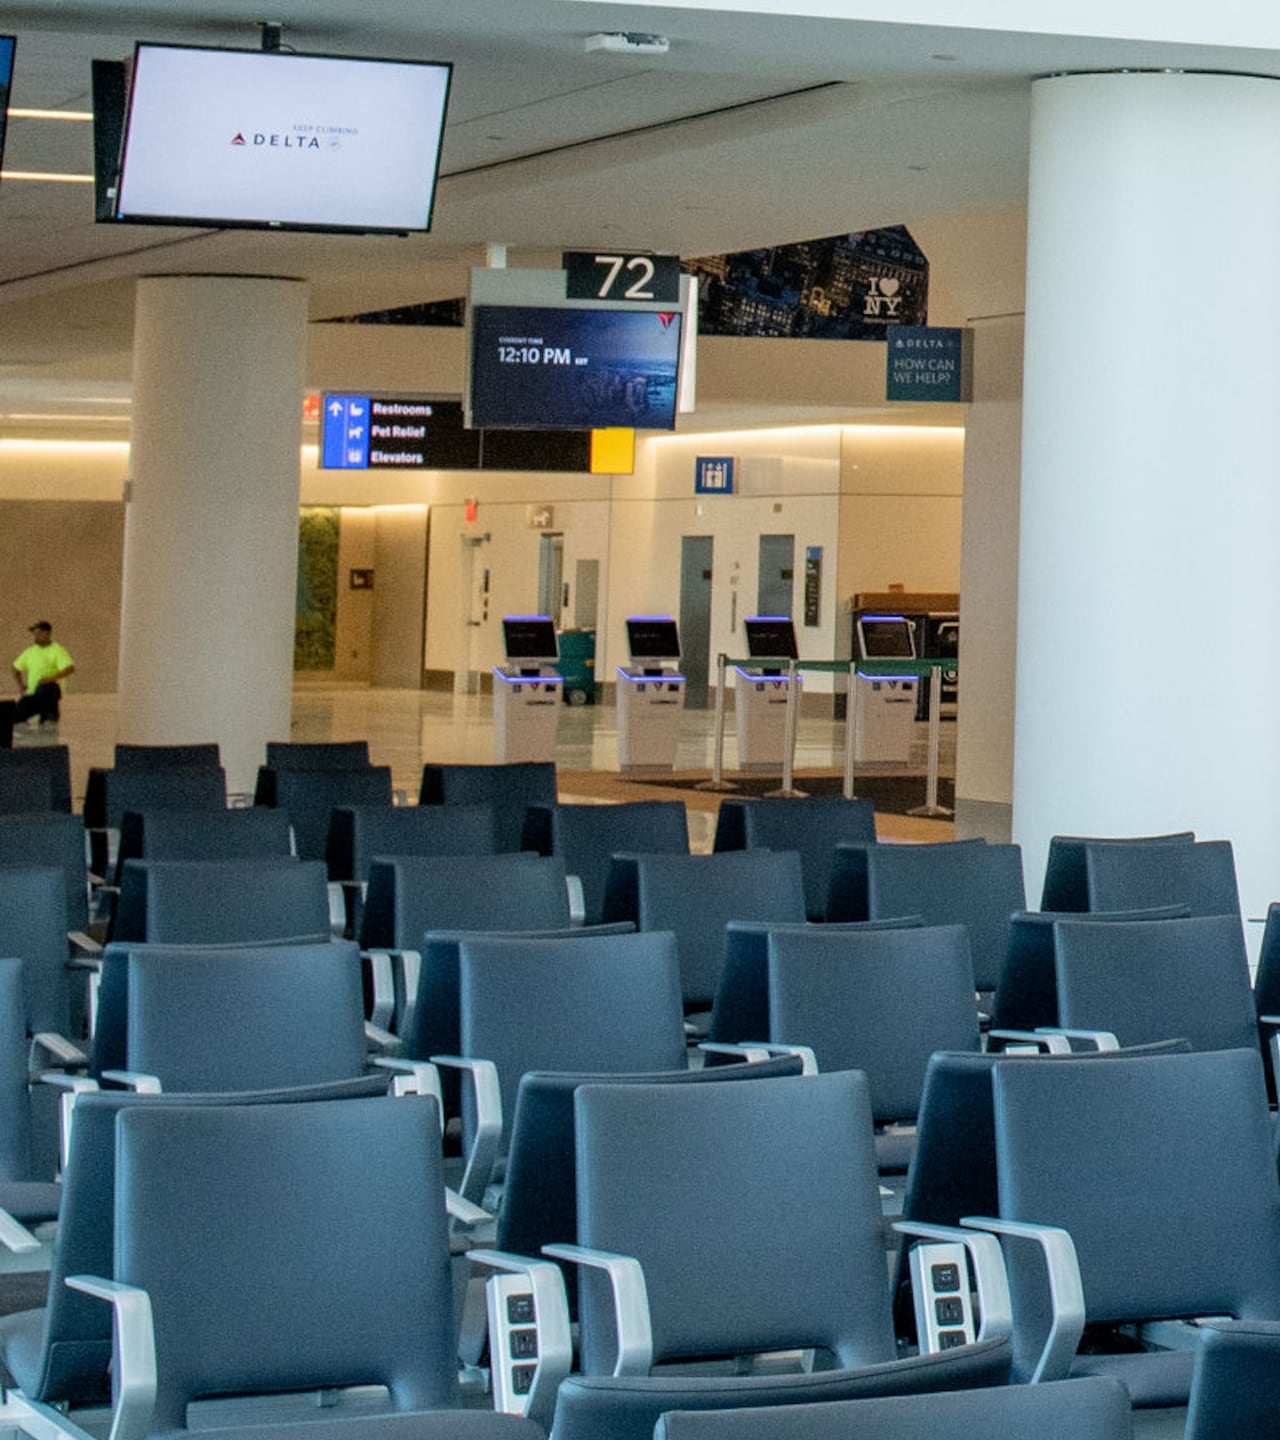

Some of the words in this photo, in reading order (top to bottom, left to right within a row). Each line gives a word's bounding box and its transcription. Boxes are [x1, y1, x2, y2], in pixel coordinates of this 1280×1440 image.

[253, 133, 320, 149] DELTA
[594, 255, 655, 299] 72
[868, 277, 879, 296] I
[863, 296, 902, 316] NY
[906, 339, 944, 349] DELTA
[497, 346, 540, 364] 12:10
[543, 347, 571, 366] PM
[894, 359, 925, 370] HOW
[928, 359, 955, 370] CAN
[893, 372, 912, 383] WE
[916, 372, 951, 384] HELP?
[372, 402, 433, 417] Restrooms
[371, 425, 391, 438] Pet
[392, 425, 426, 438] Relief
[371, 451, 424, 464] Elevators
